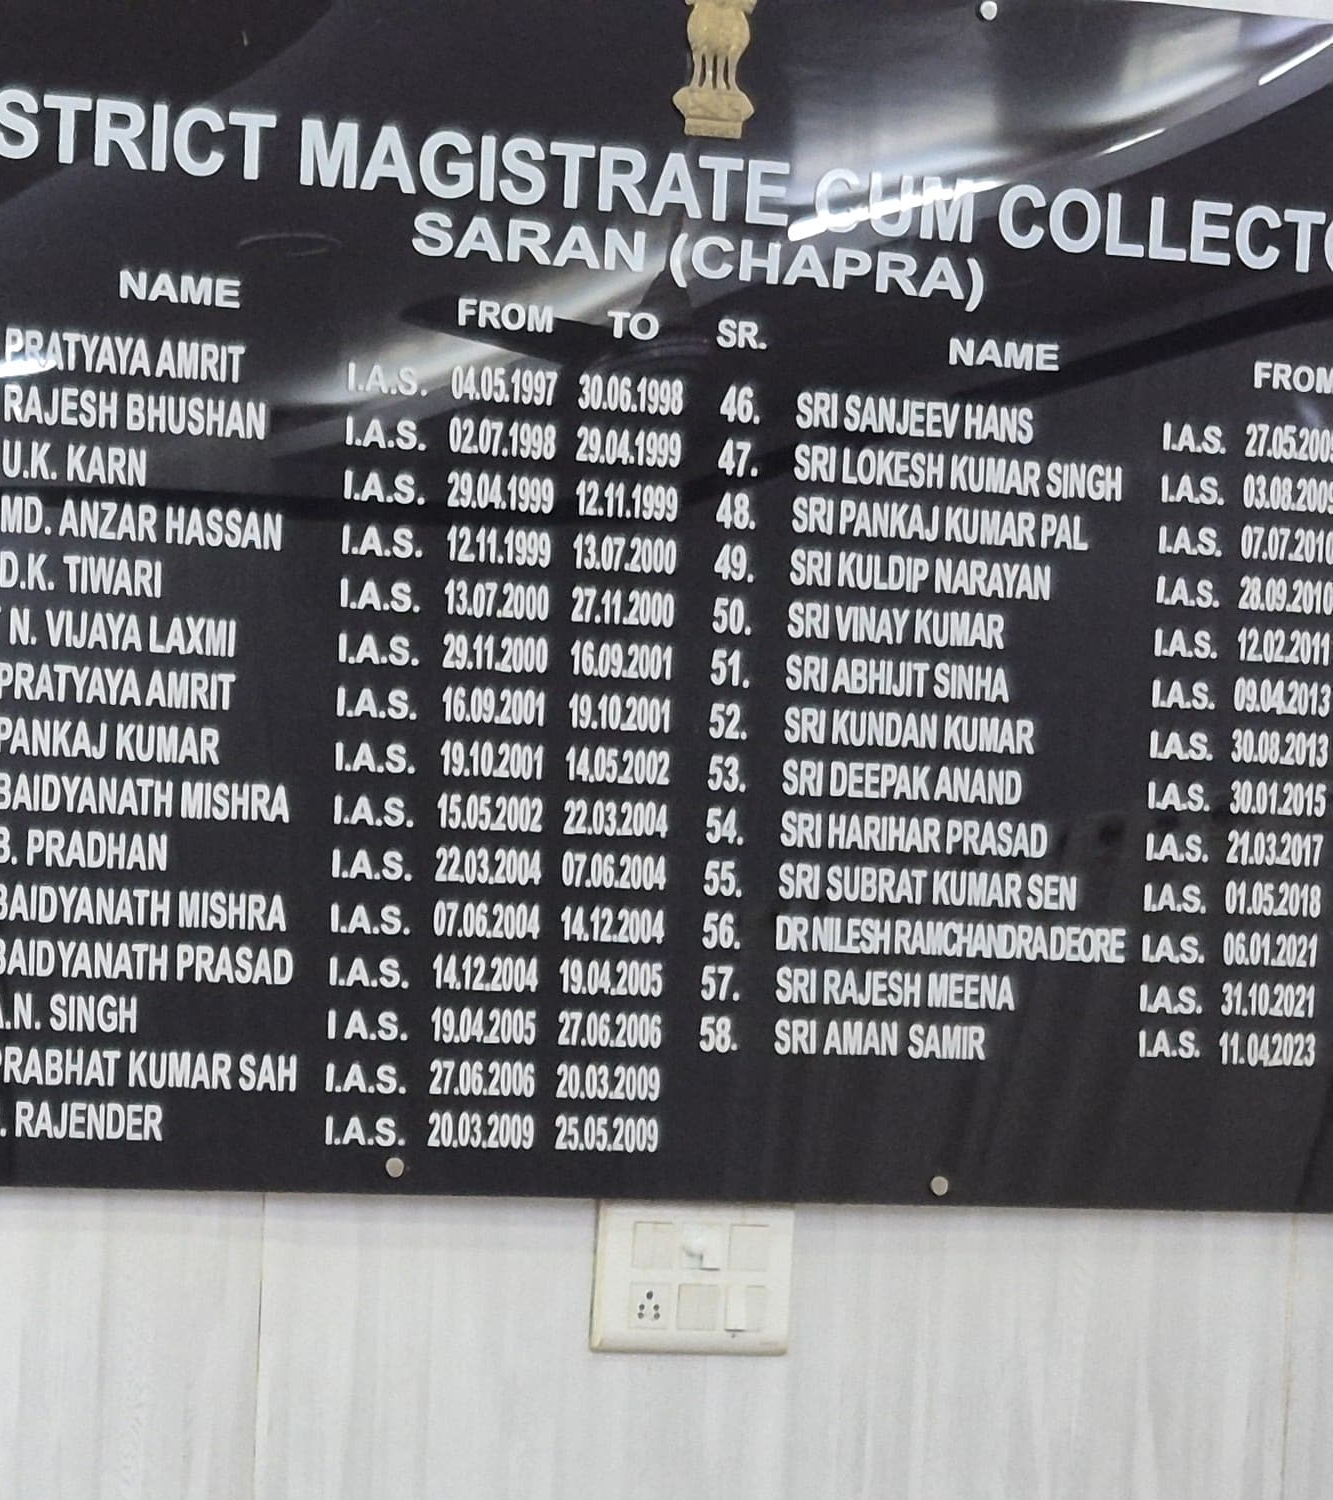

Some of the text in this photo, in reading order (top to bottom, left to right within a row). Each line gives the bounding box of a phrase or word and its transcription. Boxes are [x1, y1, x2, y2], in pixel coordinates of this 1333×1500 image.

[298, 118, 791, 227] MAGISTRATE
[814, 168, 974, 244] CUM
[998, 183, 1333, 275] COLLECT
[410, 210, 984, 312] SARAN (CHAPRA)
[119, 269, 241, 309] NAME
[457, 299, 553, 333] FROM
[607, 311, 659, 341] TO
[717, 319, 768, 350] SR.
[4, 328, 150, 378] PRATYAYA
[155, 340, 245, 384] AMRIT
[948, 337, 1060, 372] NAME
[347, 362, 683, 416] I.A.S. 04.05.1997 30.06.1998
[4, 385, 117, 429] RAJESH
[127, 394, 266, 441] BHUSHAN
[721, 386, 1034, 444] 46. SRI SANJEEV HANS
[2, 441, 57, 480] U.K.
[67, 445, 147, 487] KARN
[718, 439, 1123, 502] 47. SRI LOKESH KUMAR SINGH
[0, 495, 51, 535] MD.
[59, 499, 157, 543] ANZAR
[166, 506, 282, 552] HASSAN
[717, 492, 1088, 551] 48. SRI PANKAJ KUMAR PAL
[0, 551, 54, 591] D.K.
[63, 556, 162, 599] TIWARI
[714, 544, 1051, 600] 49. SRI KULDIP NARAYAN
[10, 608, 37, 646] N.
[45, 610, 142, 652] VIJAYA
[150, 616, 236, 657] LAXMI
[712, 598, 1004, 650] 50. SRI VINAY KUMAR
[145, 669, 235, 711] AMRIT
[711, 649, 1009, 702] 51. SRI ABHIJIT SINHA
[116, 724, 219, 765] KUMAR
[709, 703, 1035, 755] 52. SRI KUNDAN KUMAR
[180, 781, 289, 823] MISHRA
[707, 755, 1021, 805] 53. SRI DEEPAK ANAND
[27, 830, 167, 871] PRADHAN
[706, 808, 1048, 858] 54. SRI HARIHAR PRASAD
[703, 860, 1077, 911] 55. SRI SUBRAT KUMAR SEN
[178, 890, 286, 932] MISHRA
[702, 912, 1126, 963] 56. DR NILESH RAMCHANDRA DEORE
[176, 944, 293, 985] PRASAD
[701, 965, 1015, 1011] 57. SRI RAJESH MEENA
[50, 994, 137, 1033] SINGH
[1140, 981, 1315, 1018] I.A.S. 31.10.2021
[699, 1016, 985, 1060] 58. SRI AMAN SAMIR
[129, 1051, 231, 1090] KUMAR
[239, 1054, 296, 1092] SAH
[15, 1102, 163, 1141] RAJENDER
[325, 1111, 658, 1153] I.A.S. 20.03.2009 25.05.2009
